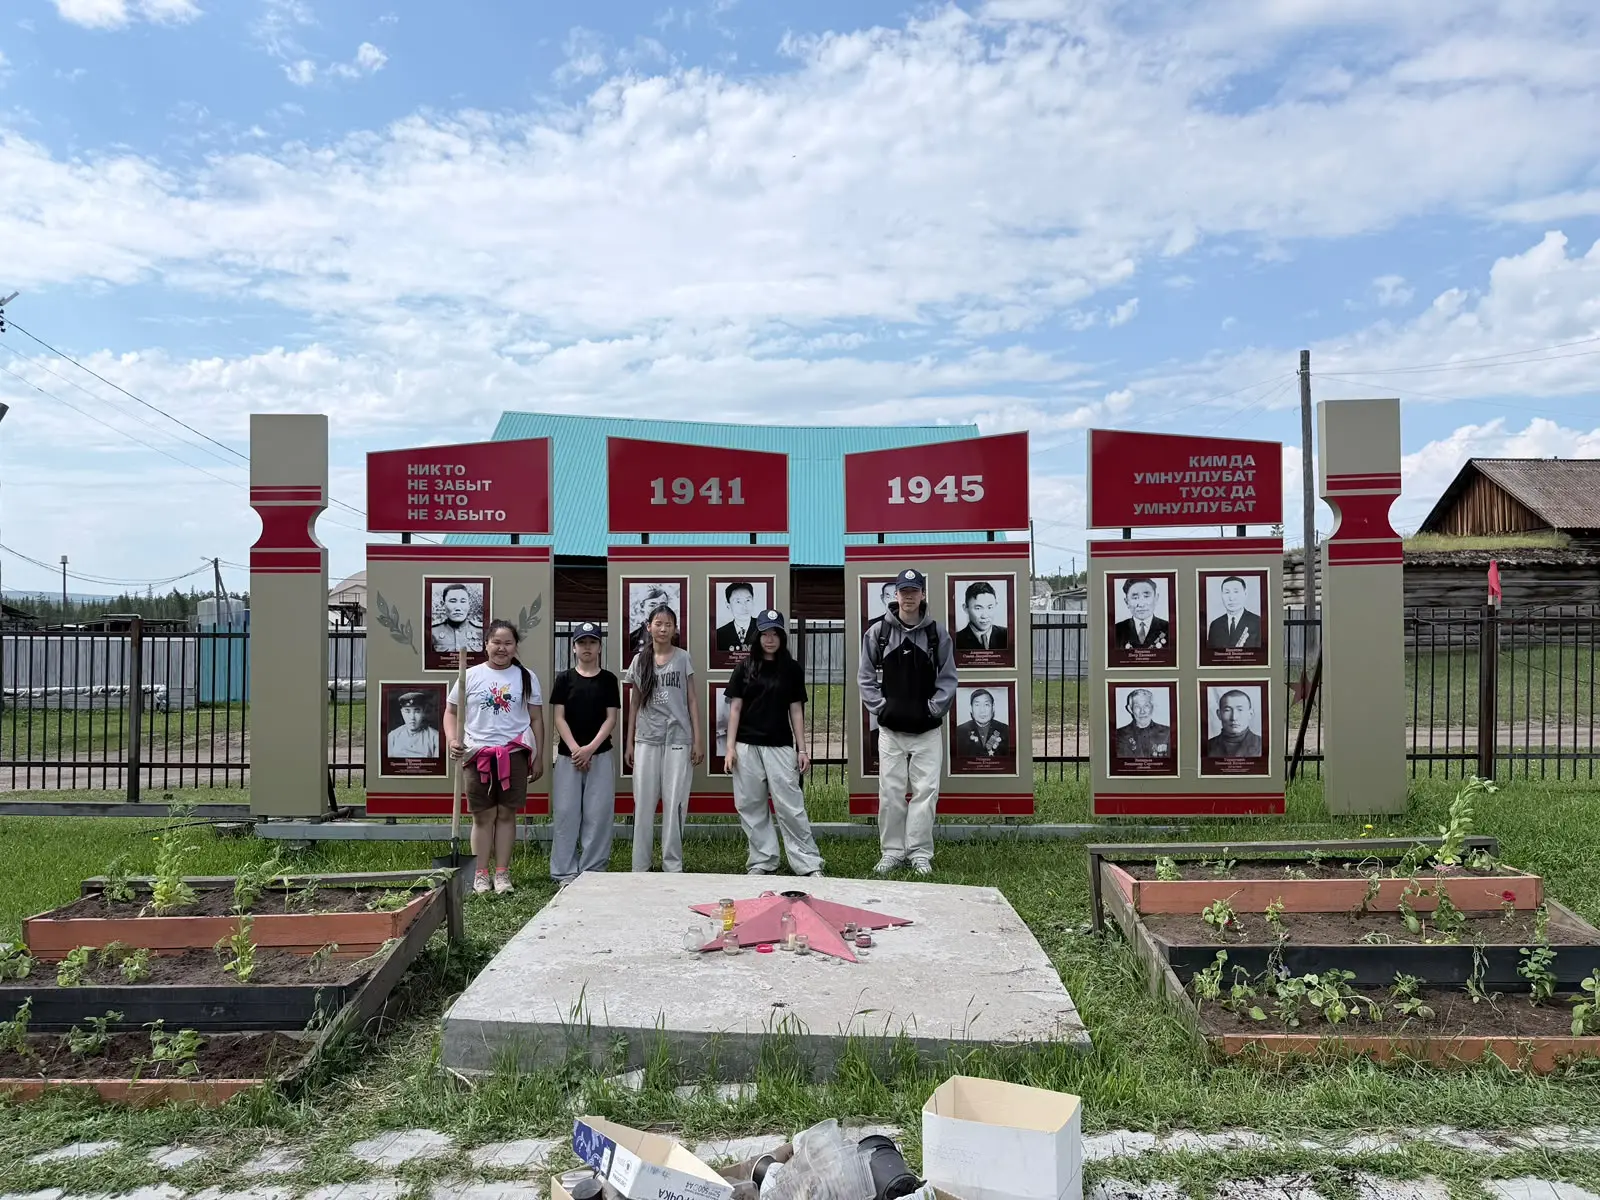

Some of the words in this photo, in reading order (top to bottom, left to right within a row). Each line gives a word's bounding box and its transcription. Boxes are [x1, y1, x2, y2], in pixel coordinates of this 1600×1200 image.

[1189, 455, 1227, 468] КИМ
[1228, 454, 1256, 469] ДА
[407, 464, 466, 476] НИКТО
[1133, 470, 1256, 484] УМНУЛЛУБАТ
[407, 479, 428, 491] НЕ
[434, 479, 492, 492] ЗАБЫТ
[650, 477, 745, 505] 1941
[887, 475, 985, 505] 1945
[1179, 486, 1226, 498] ТУОХ
[1230, 485, 1256, 499] ДА
[407, 494, 430, 505] НИ
[434, 494, 468, 506] ЧТО
[407, 508, 429, 520] НЕ
[434, 509, 506, 521] ЗАБЫТО
[1133, 500, 1256, 515] УМНУЛЛУБАТ
[661, 671, 681, 688] YORK
